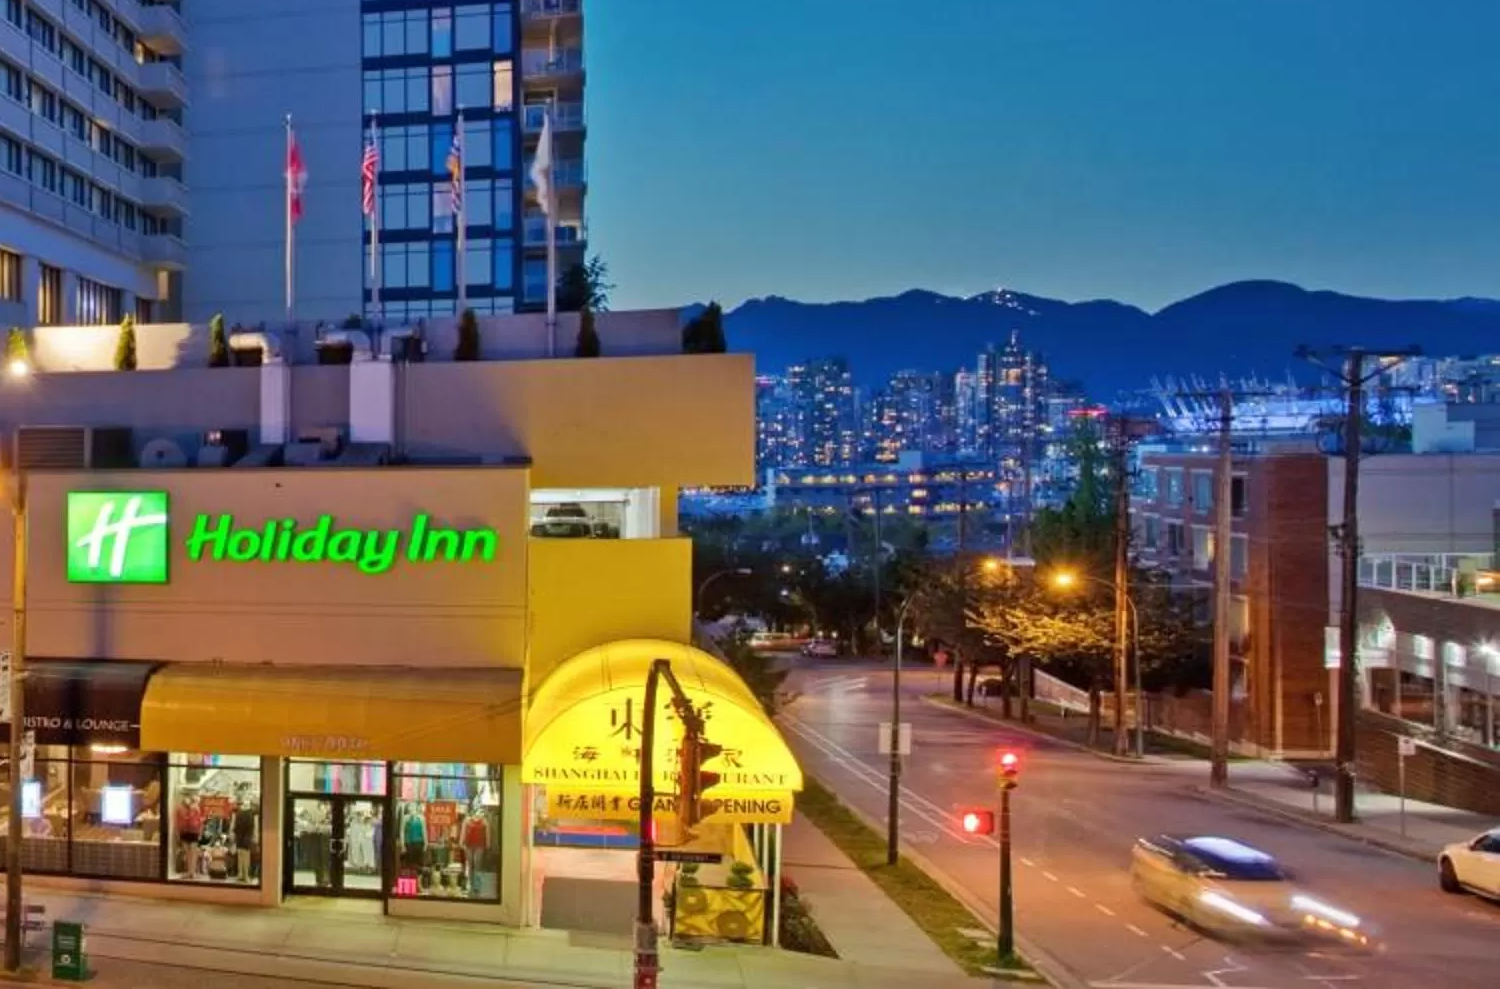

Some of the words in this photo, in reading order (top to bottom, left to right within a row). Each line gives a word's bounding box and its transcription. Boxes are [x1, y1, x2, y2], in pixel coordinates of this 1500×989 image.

[185, 514, 399, 574] Holiday
[406, 513, 498, 563] Inn
[75, 717, 130, 732] LOUNGE
[533, 765, 631, 781] SHANGHAI
[627, 797, 686, 813] GAN
[706, 797, 782, 815] PENING
